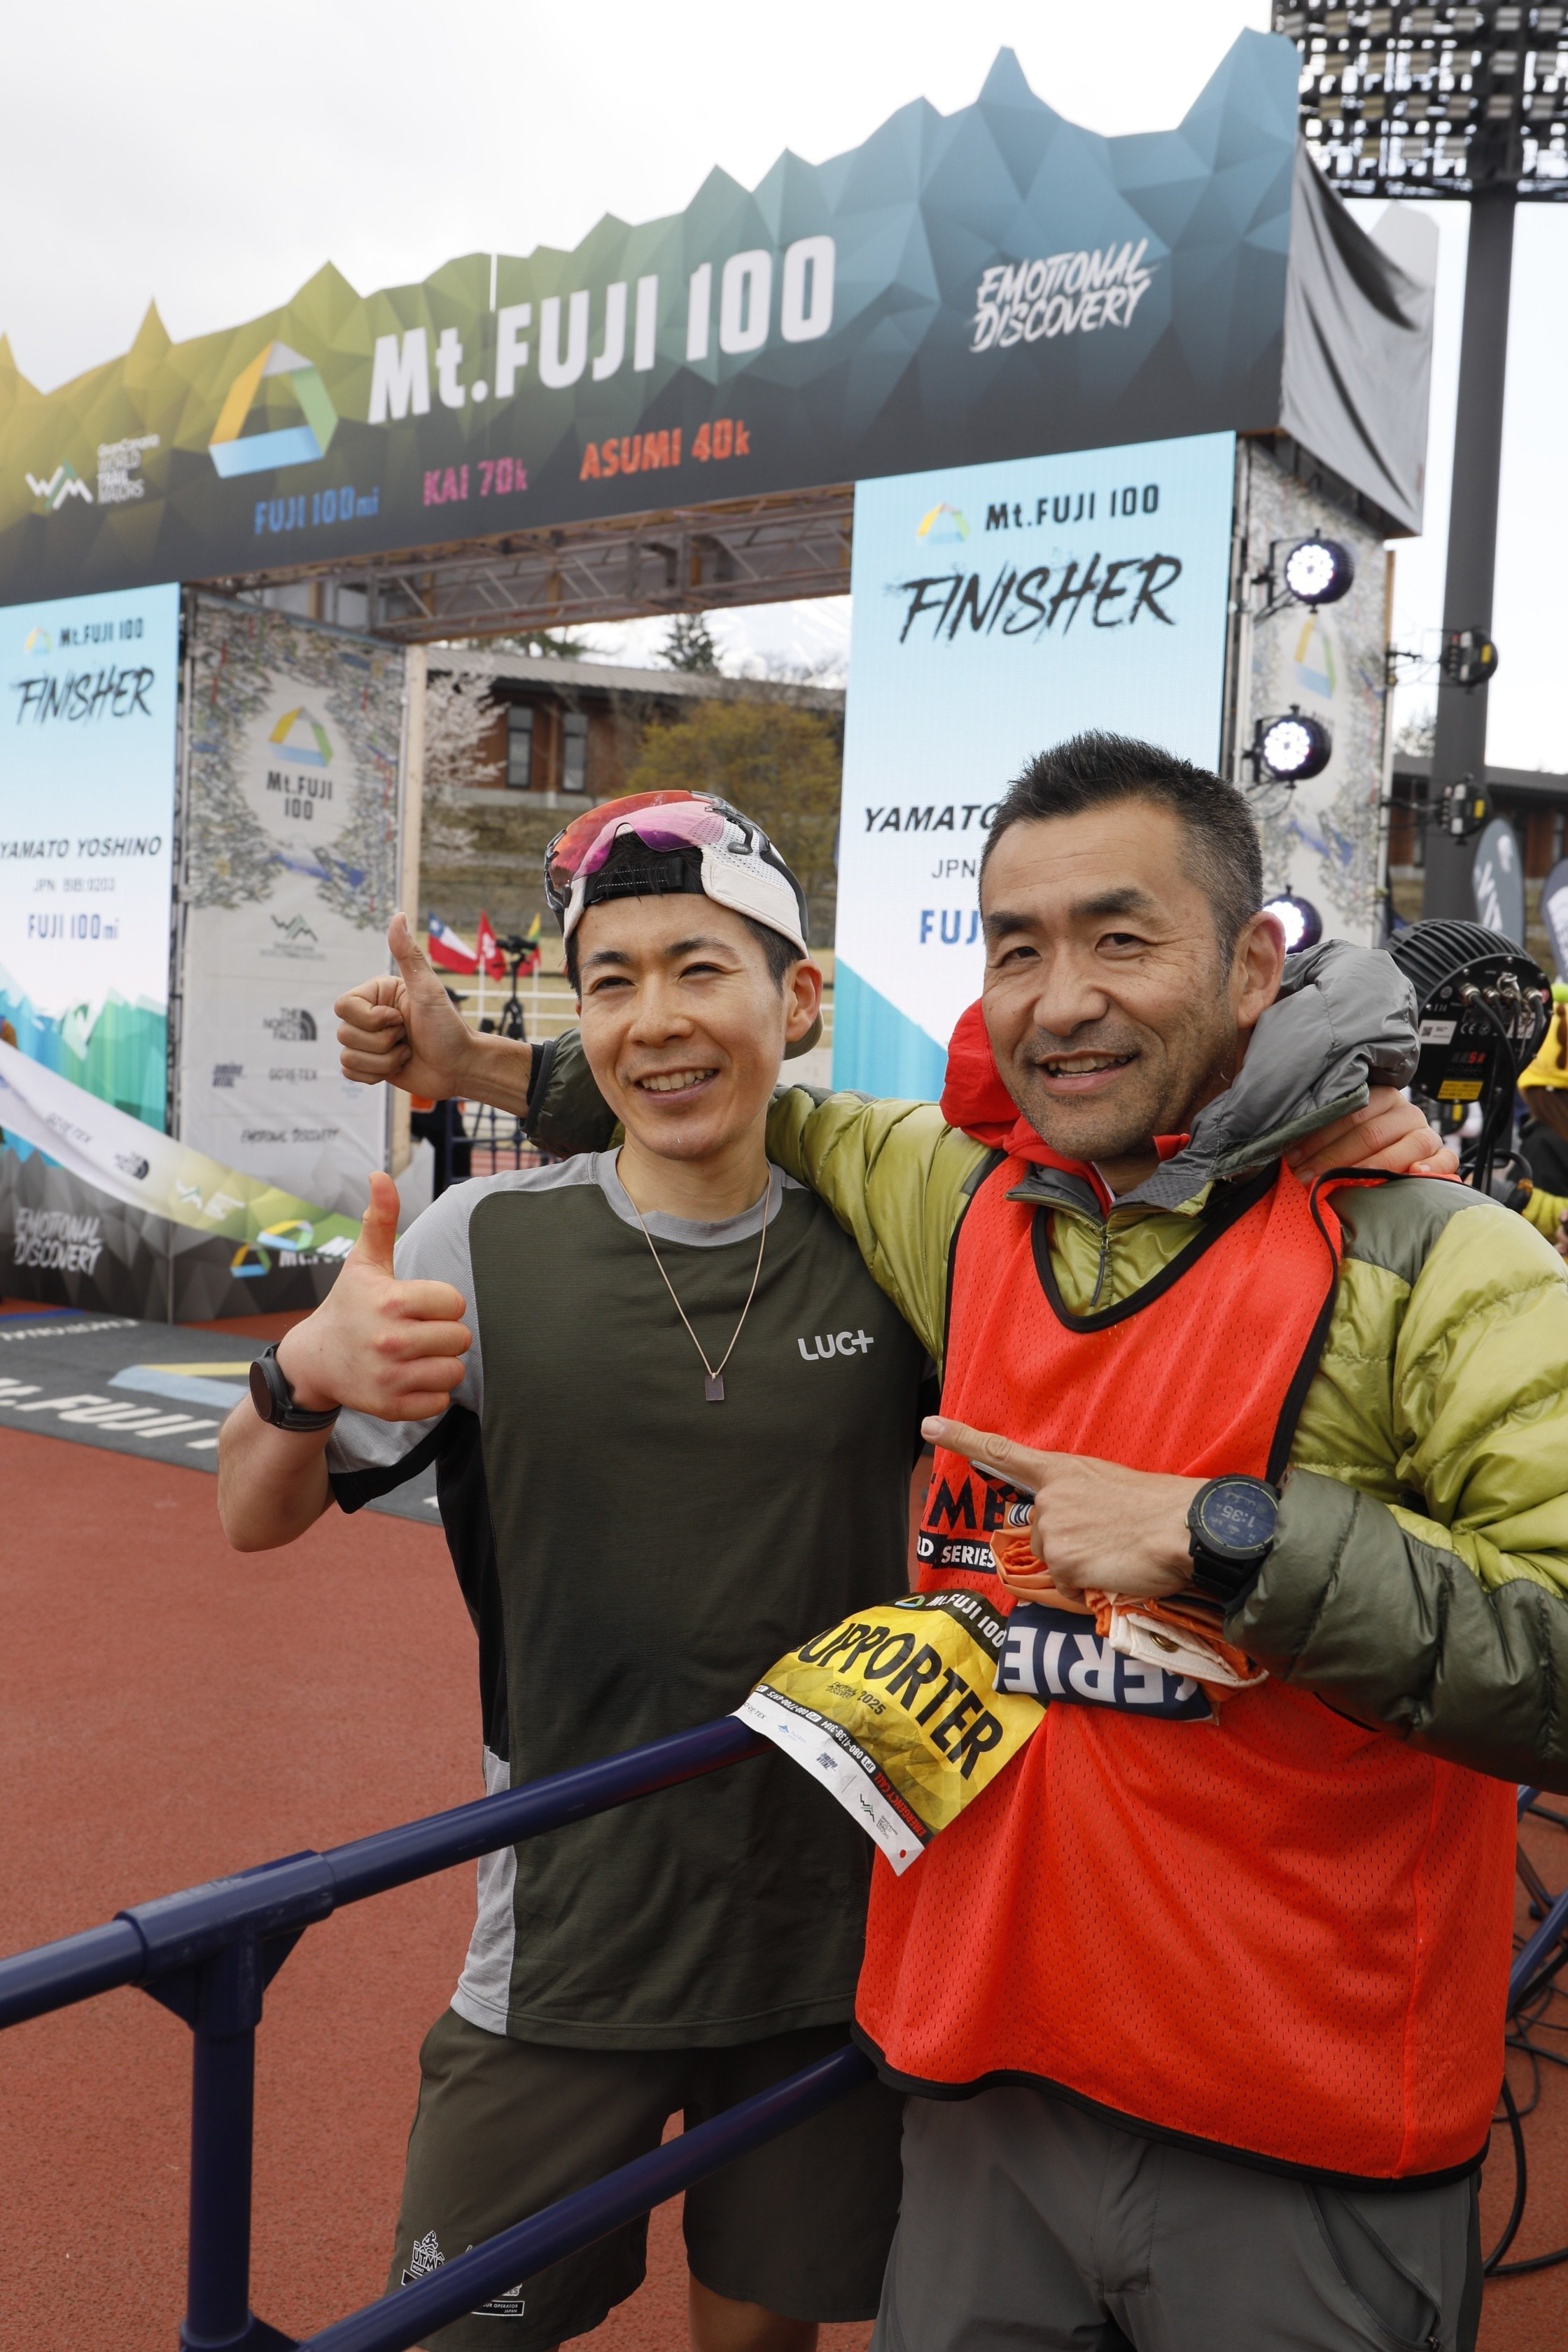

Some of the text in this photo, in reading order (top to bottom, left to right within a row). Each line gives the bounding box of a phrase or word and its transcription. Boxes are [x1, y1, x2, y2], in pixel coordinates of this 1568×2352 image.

[976, 237, 1161, 309] EMOTIONAL
[368, 234, 836, 425] Mt.FUJI 100
[967, 277, 1152, 353] DISCOVERY
[579, 419, 750, 482] ASUMI 40k
[424, 456, 528, 507] KAI 70k
[253, 485, 379, 535] FUJI 100mi
[984, 484, 1160, 533] Mt.FUJI 100
[890, 552, 1183, 645] FINISHER
[59, 616, 144, 648] Mt.FUJI 100
[13, 663, 155, 725] FINISHER
[266, 771, 332, 801] Mt.FUJI
[284, 797, 314, 821] 100
[865, 804, 996, 833] YAMATO
[0, 836, 162, 860] YAMATO YOSHINO
[932, 859, 976, 878] JPN
[28, 913, 64, 940] FUJI
[919, 909, 981, 945] FUJ
[15, 1208, 104, 1246] EMOTIONAL
[14, 1233, 103, 1276] DISCOVERY
[941, 1545, 996, 1568] SERIES
[925, 1593, 1007, 1648] Mt.FUJI 100
[743, 1702, 768, 1720] ORE-TEX
[795, 1622, 1004, 1781] UPPORTER
[857, 1690, 887, 1715] 2025
[874, 1771, 890, 1792] CALL
[886, 1787, 927, 1837] EMERGENCY
